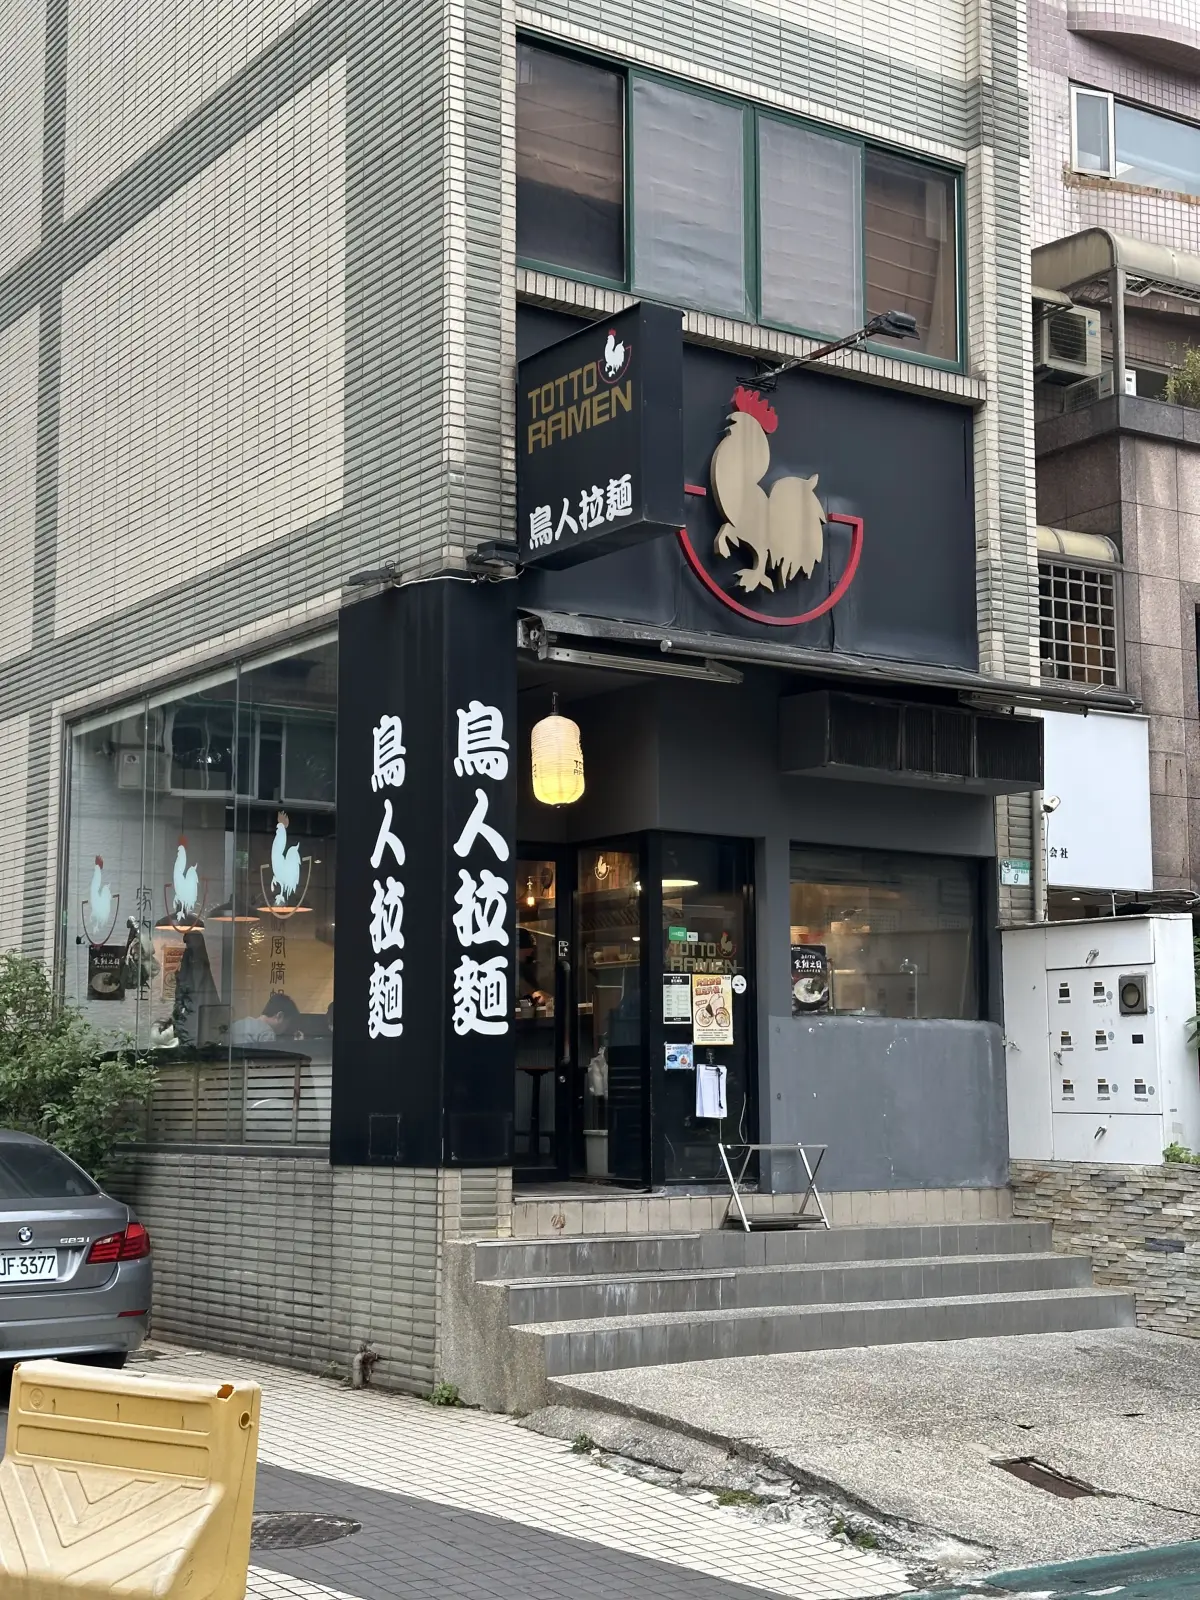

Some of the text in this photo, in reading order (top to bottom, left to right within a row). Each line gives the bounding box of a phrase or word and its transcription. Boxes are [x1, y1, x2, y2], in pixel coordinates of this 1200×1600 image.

[527, 361, 597, 419] TOTTO
[528, 380, 632, 454] RAMEN
[1013, 873, 1020, 884] 9
[670, 940, 717, 957] TOTTO
[670, 956, 738, 974] RAMEN
